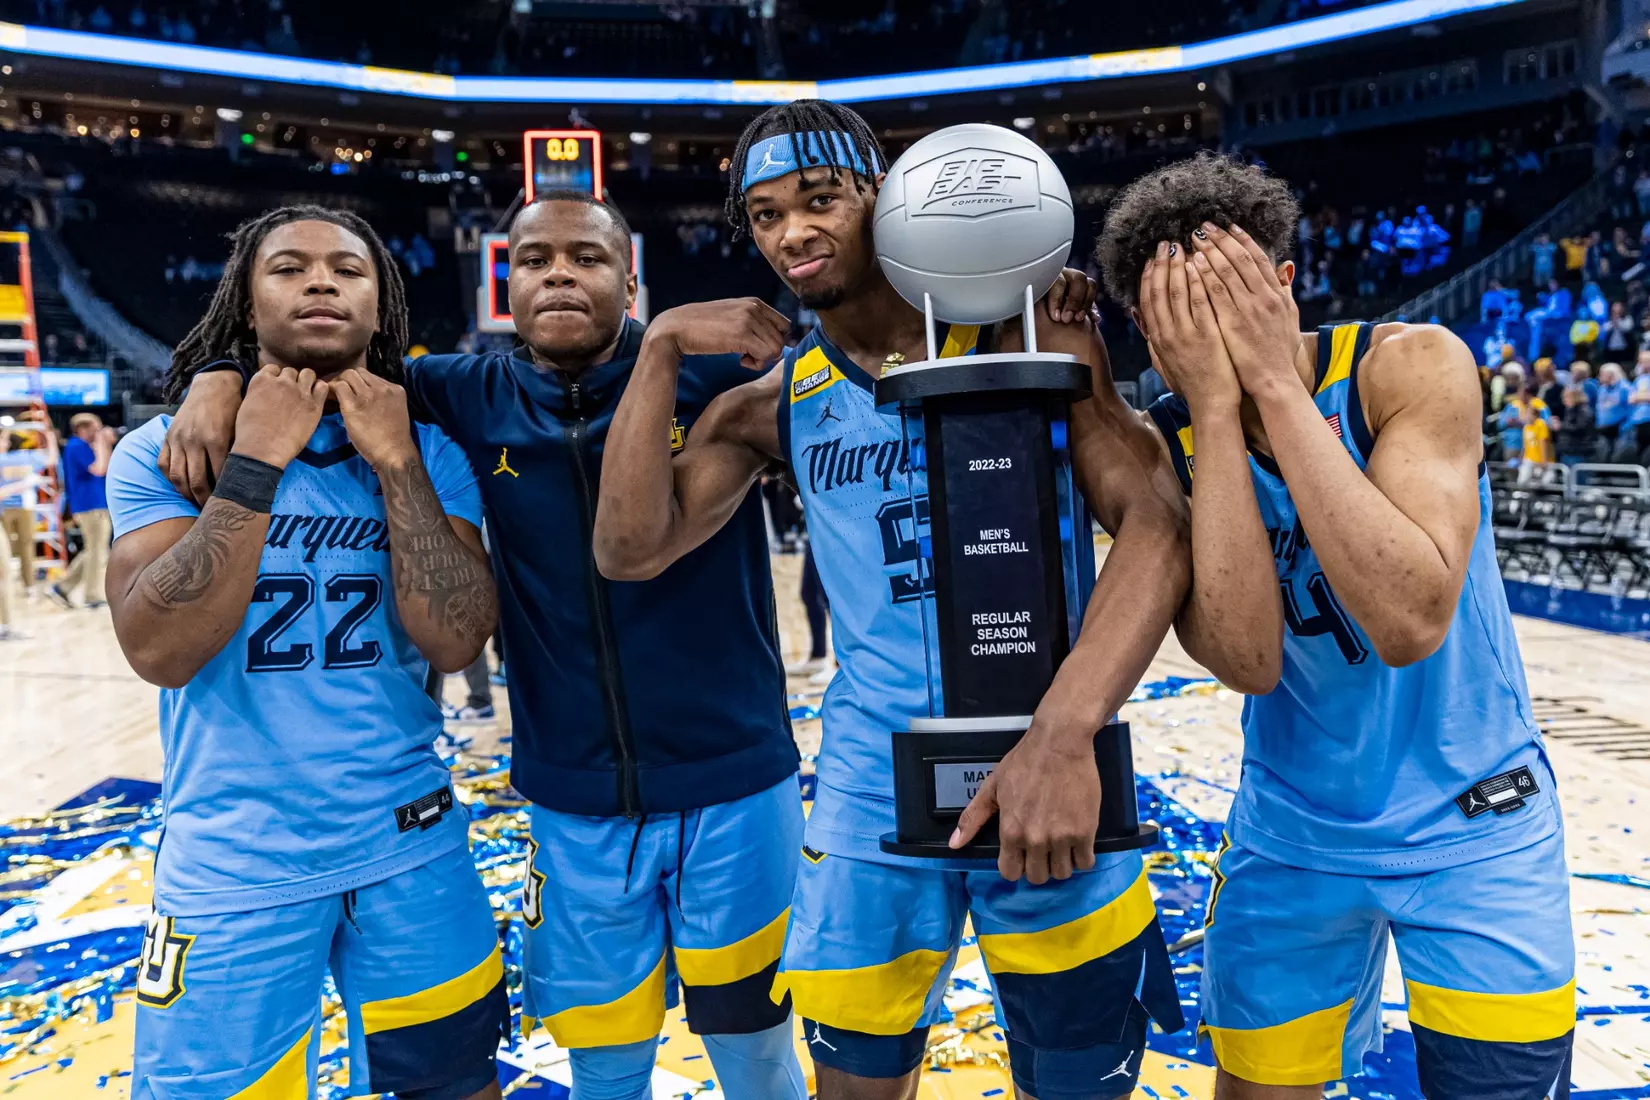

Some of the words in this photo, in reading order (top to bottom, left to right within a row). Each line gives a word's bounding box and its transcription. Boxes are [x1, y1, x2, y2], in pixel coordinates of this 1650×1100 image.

[547, 138, 579, 161] 0.0
[936, 159, 1006, 180] BIG
[927, 175, 1022, 198] EAST
[951, 198, 1014, 207] CONFERENCE
[802, 437, 928, 494] Marqu
[969, 458, 1012, 471] 2022-23
[964, 542, 1029, 556] BASKETBALL
[246, 572, 383, 673] 22
[972, 611, 1031, 626] REGULAR
[977, 626, 1028, 640] SEASON
[971, 641, 1036, 656] CHAMPION
[1518, 775, 1531, 788] 46
